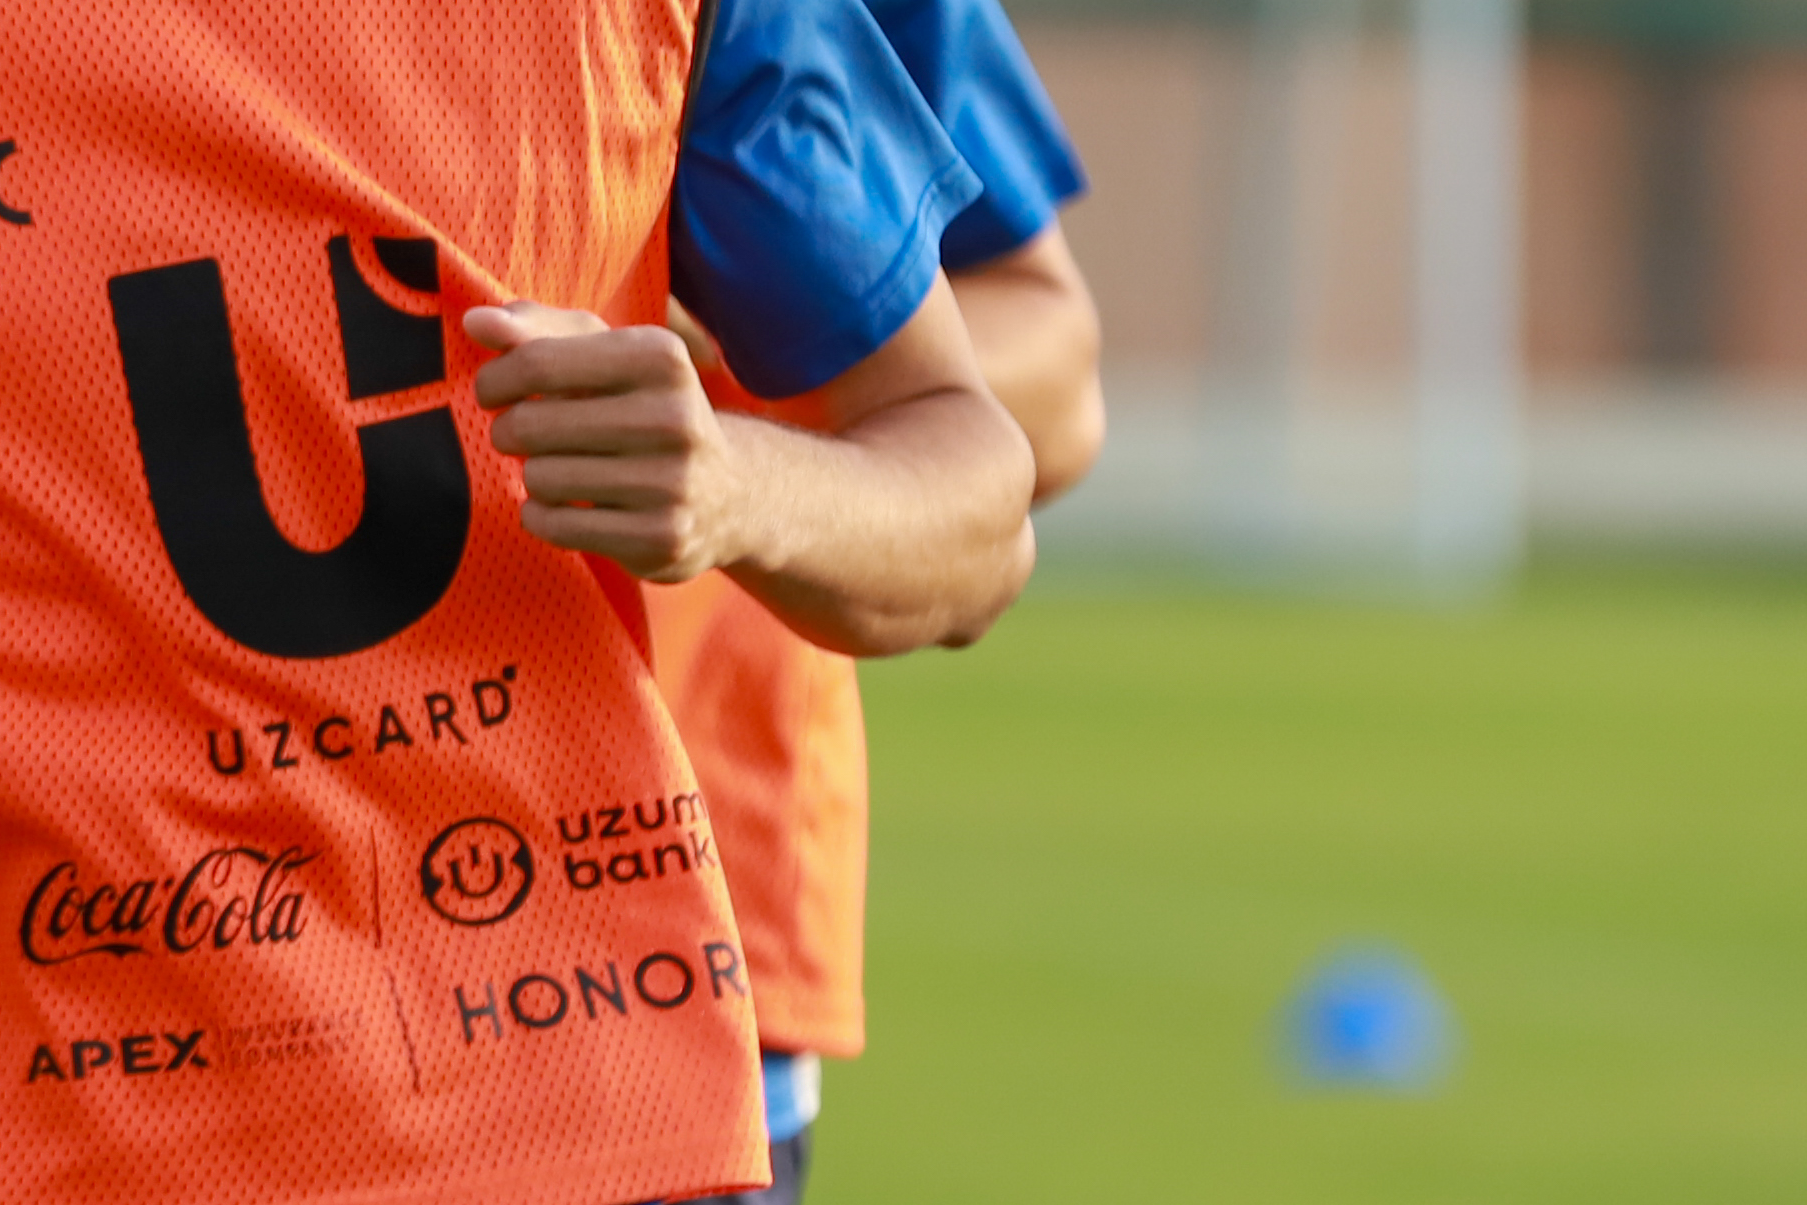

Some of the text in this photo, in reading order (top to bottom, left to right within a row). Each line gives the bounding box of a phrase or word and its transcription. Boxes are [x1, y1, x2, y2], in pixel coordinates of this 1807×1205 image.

[206, 676, 515, 776] UZCARD
[556, 792, 709, 843] uzum
[564, 830, 716, 890] bank
[453, 942, 748, 1046] HONOR
[26, 1029, 209, 1084] APEX
